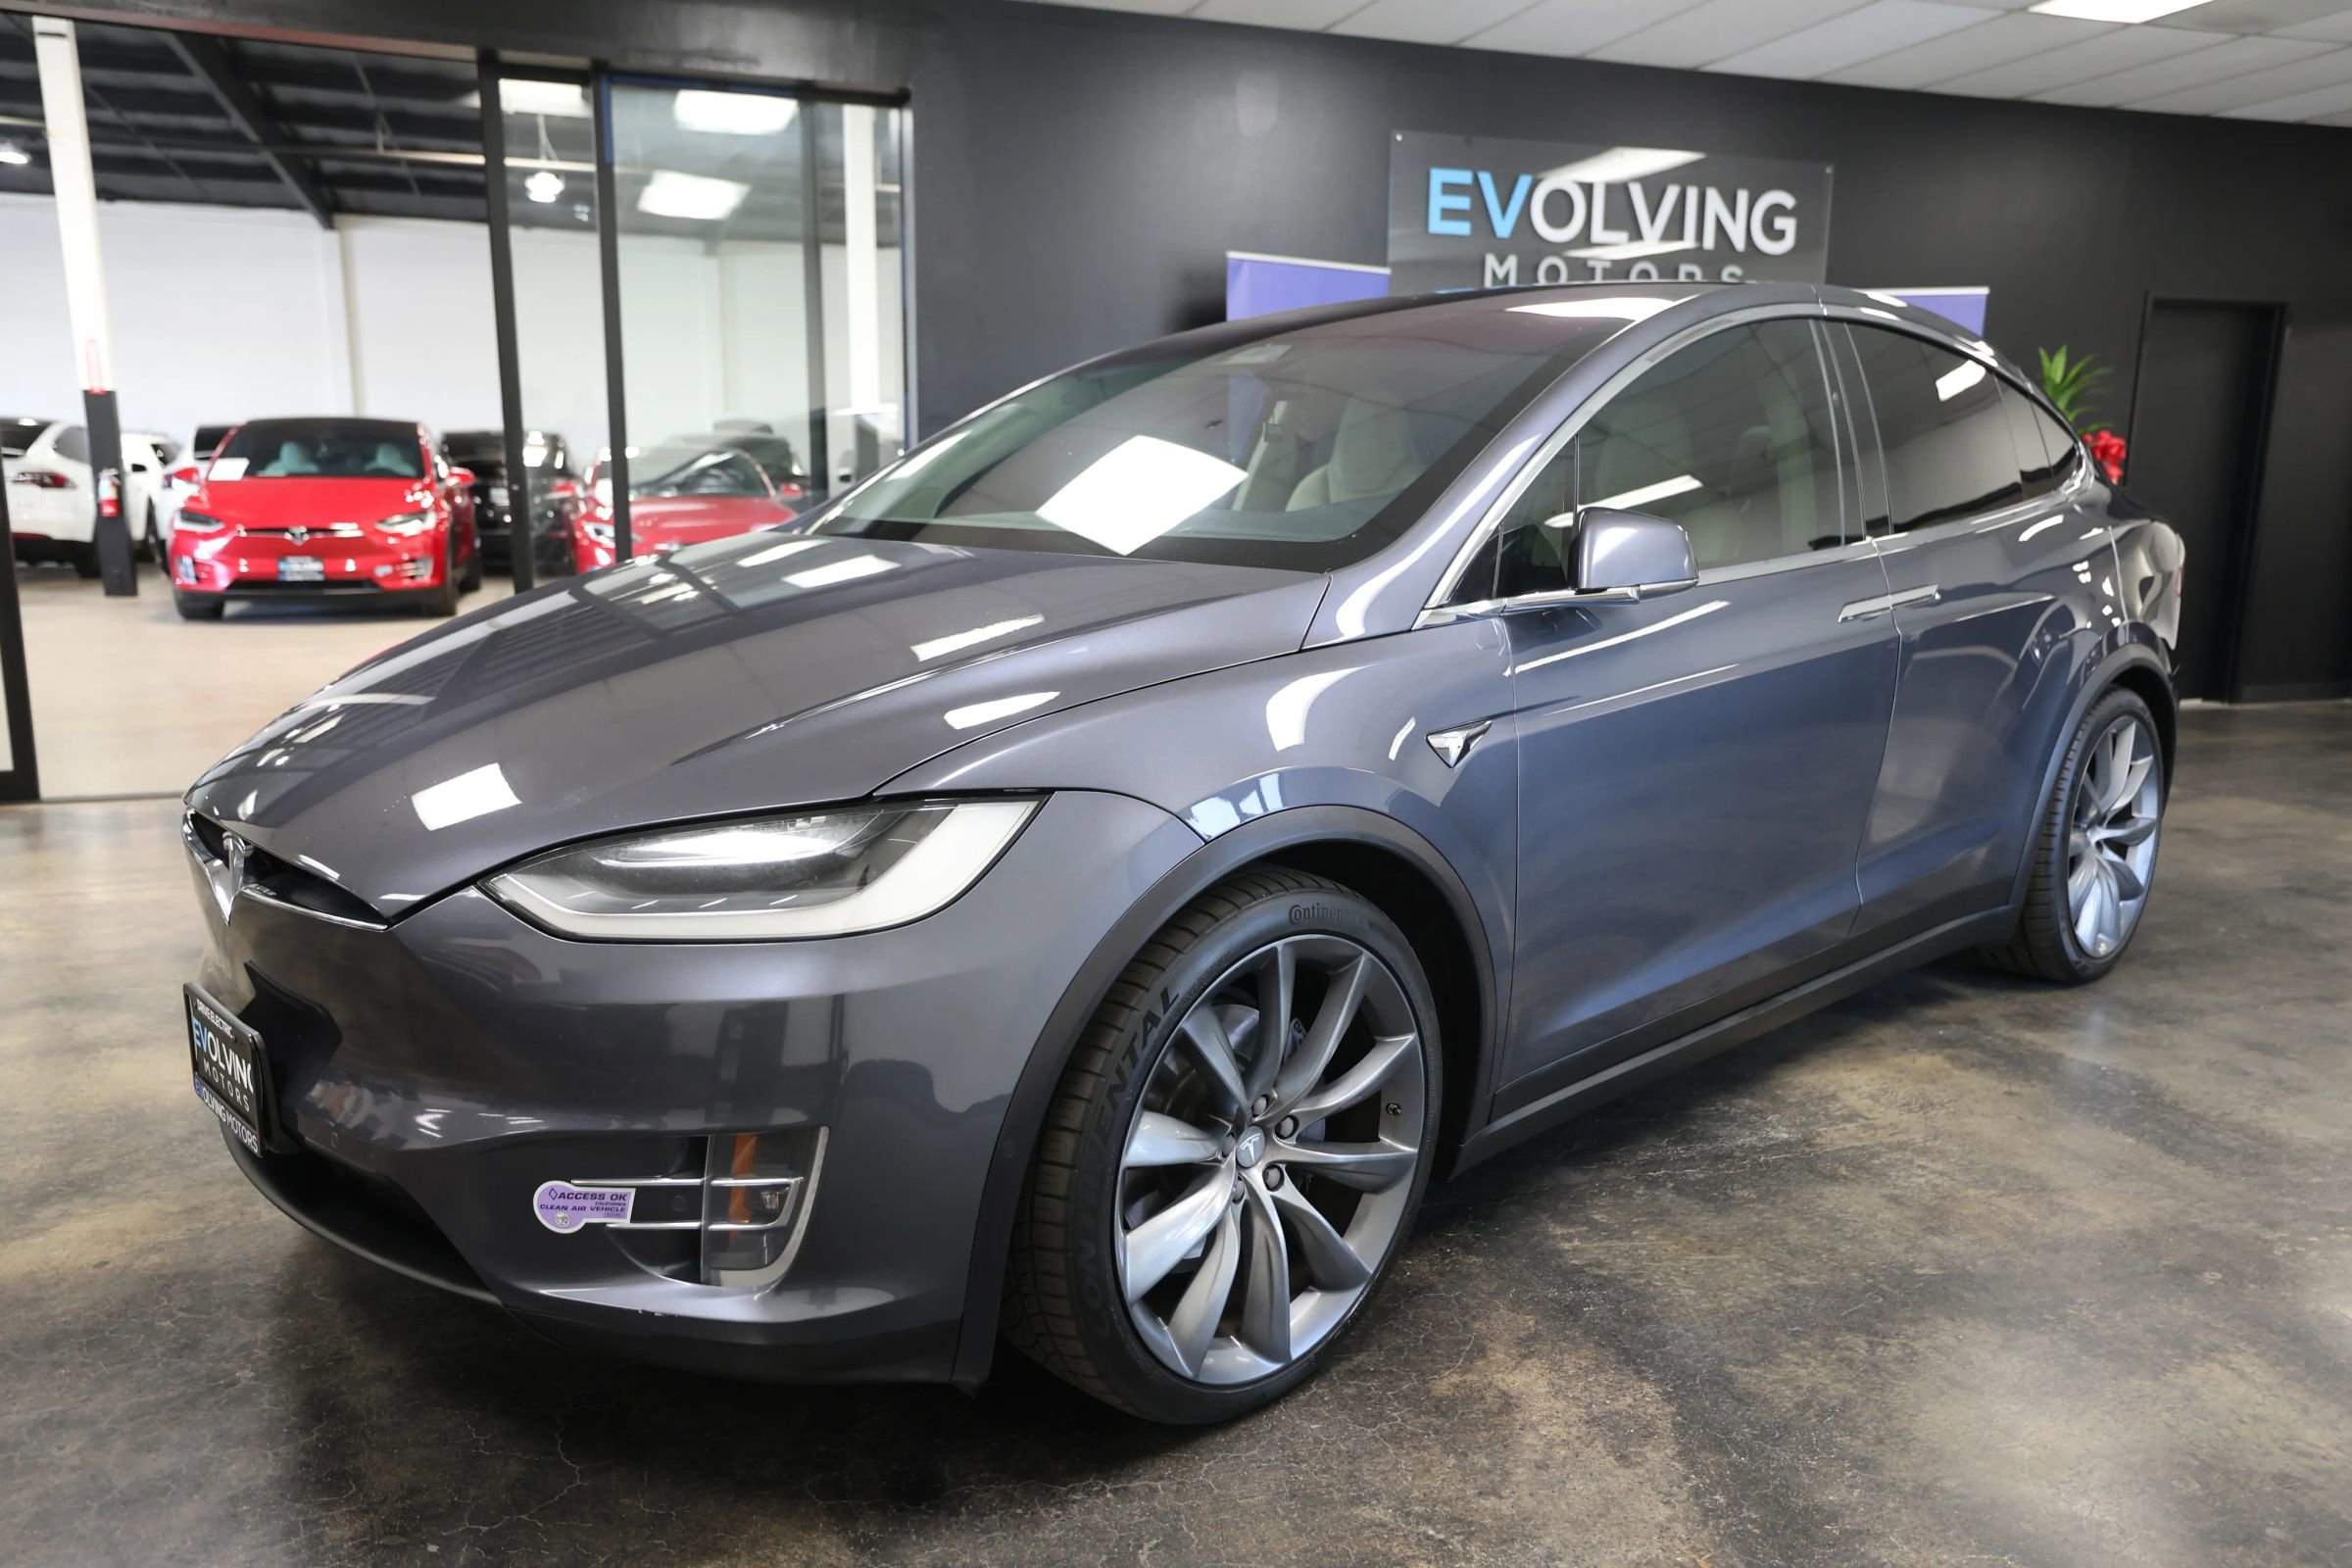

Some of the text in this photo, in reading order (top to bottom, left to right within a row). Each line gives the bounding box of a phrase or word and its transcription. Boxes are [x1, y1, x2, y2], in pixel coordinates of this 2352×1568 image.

[1428, 168, 1797, 256] EVOLVING
[1289, 903, 1366, 928] Continen
[203, 1057, 250, 1112] MOTORS
[195, 1078, 259, 1153] EVOLVING MOTORS
[558, 1192, 628, 1201] ACCESS OK
